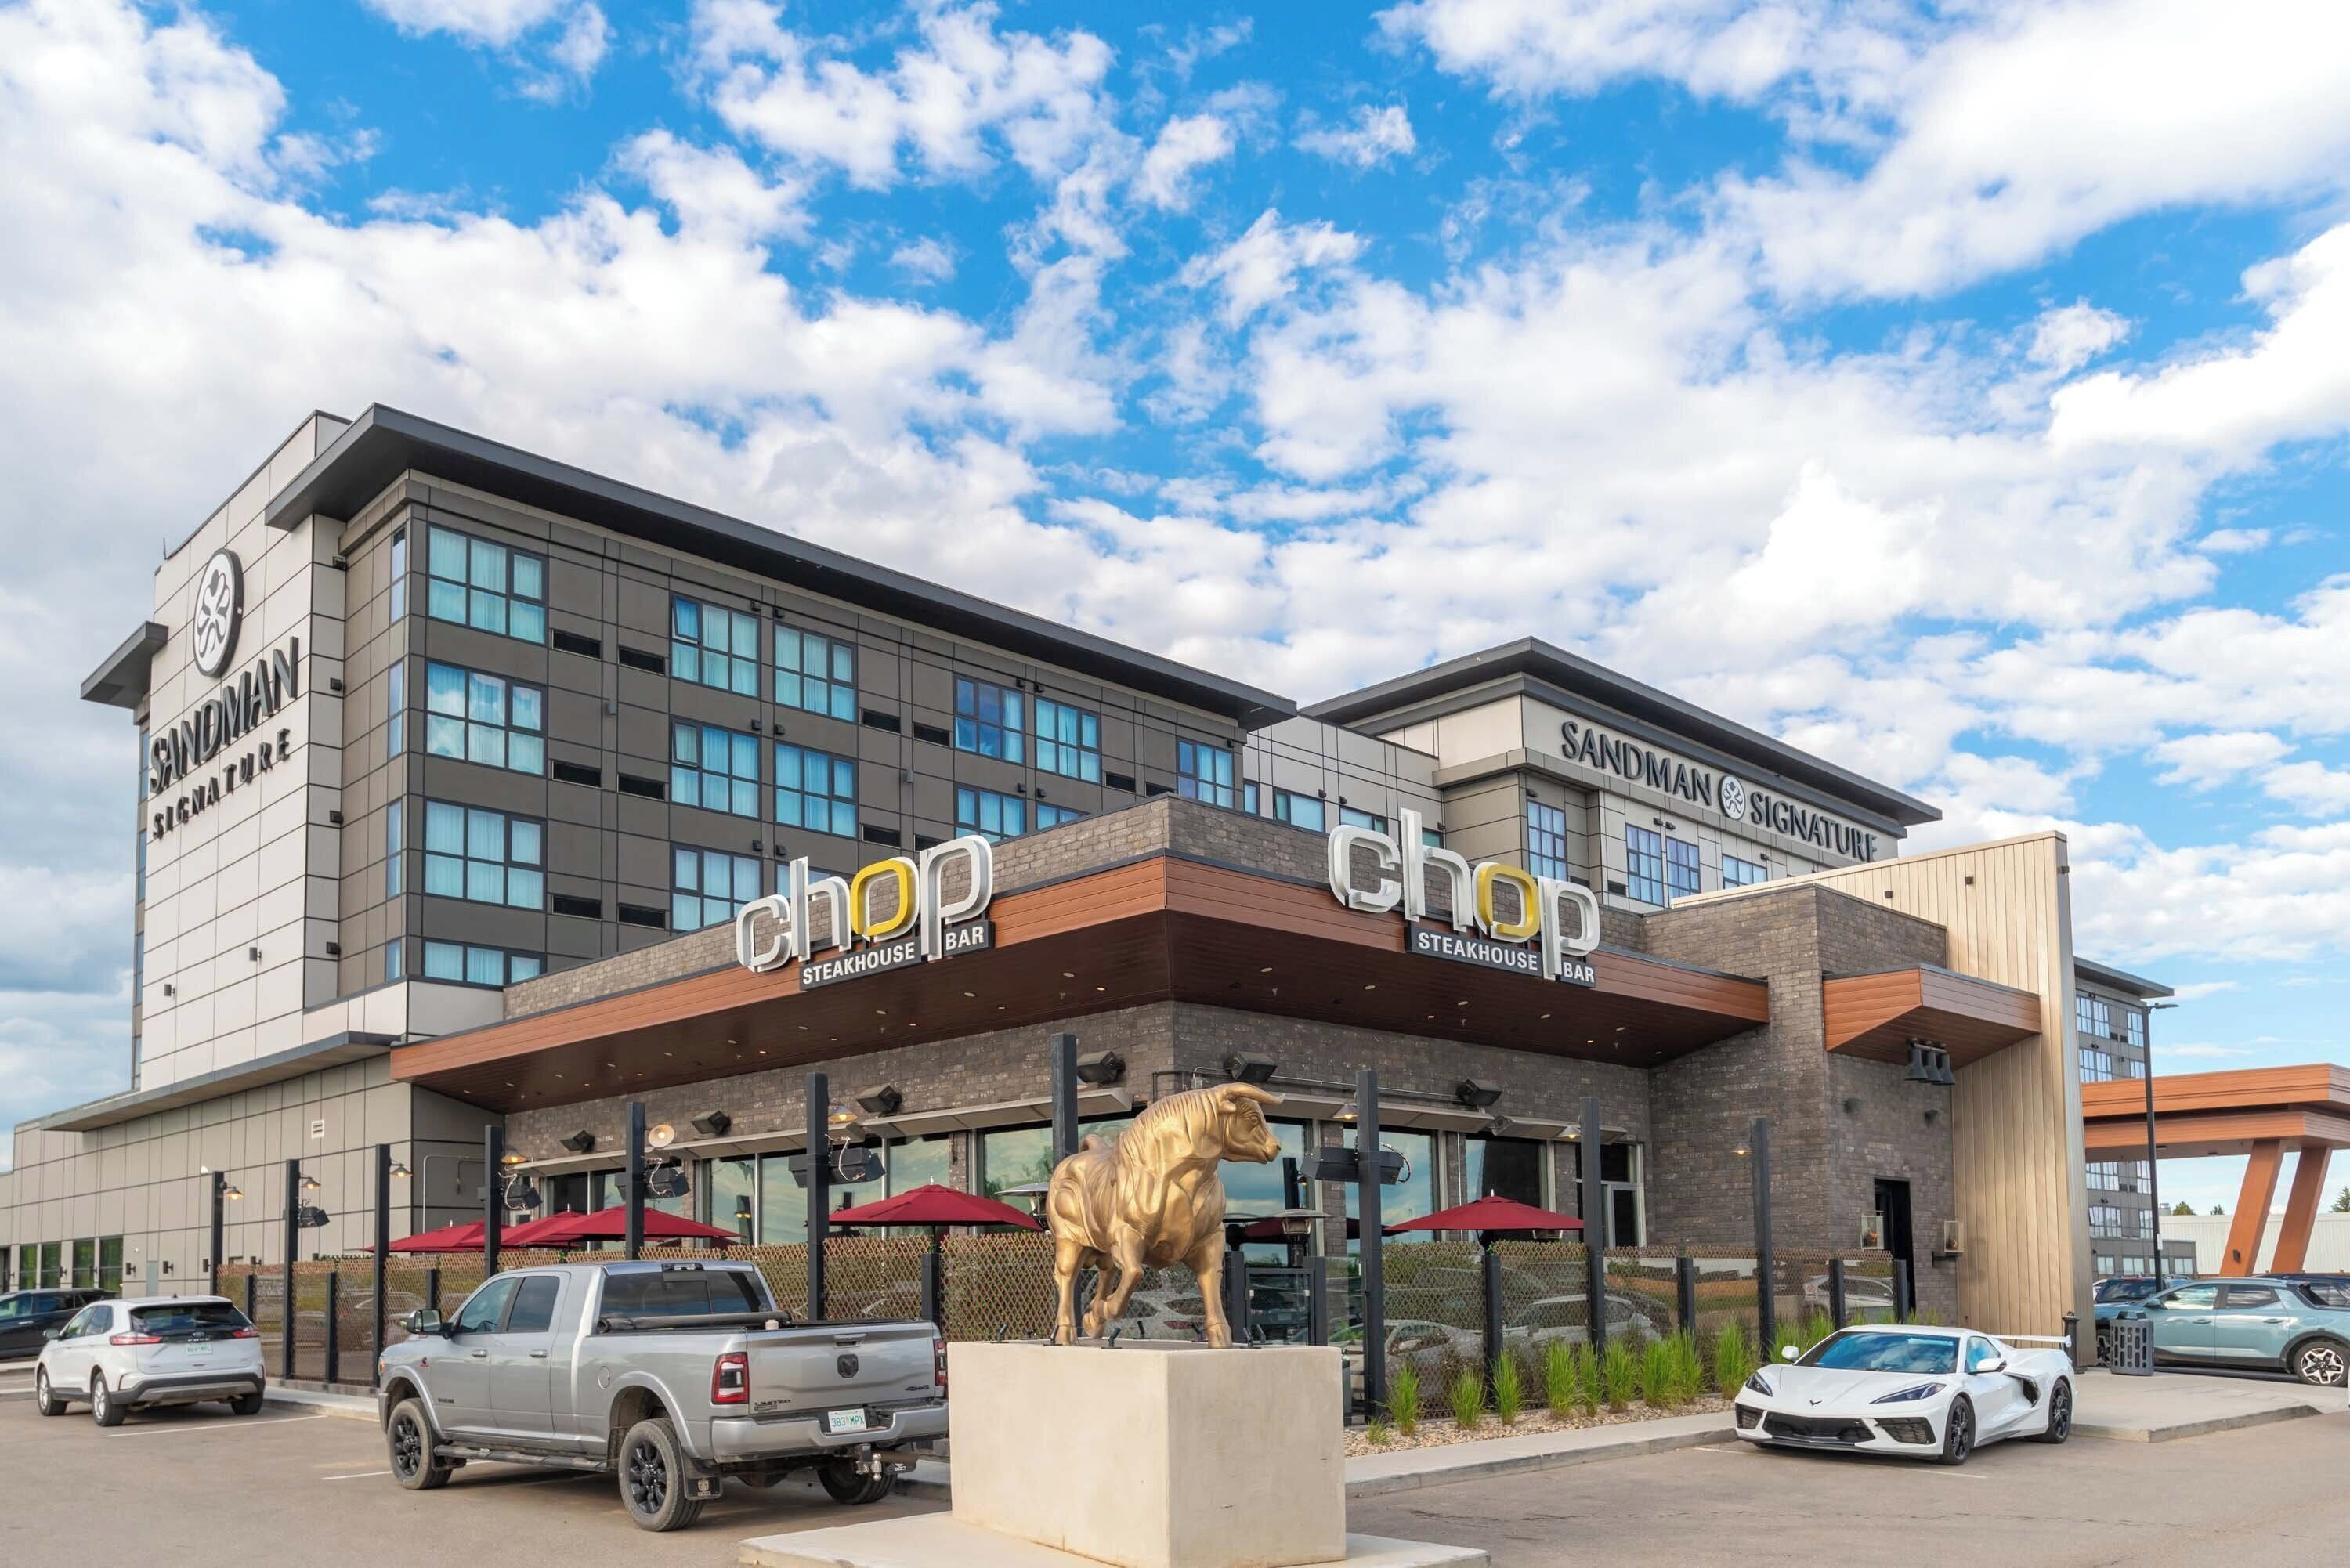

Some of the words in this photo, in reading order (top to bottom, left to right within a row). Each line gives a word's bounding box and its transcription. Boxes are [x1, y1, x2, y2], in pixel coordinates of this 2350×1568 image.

[150, 636, 299, 794] SANDMAN
[152, 728, 291, 840] SIGNATURE
[1561, 721, 1712, 806] SANDMAN
[1750, 791, 1878, 863] SIGNATURE
[736, 834, 993, 973] chop
[802, 941, 916, 985] STEAKHOUSE
[945, 925, 985, 952] BAR
[1328, 807, 1600, 981] chop
[1417, 931, 1538, 971] STEAKHOUSE
[1563, 961, 1595, 983] BAR
[831, 1416, 846, 1427] 383
[850, 1414, 865, 1425] MPX
